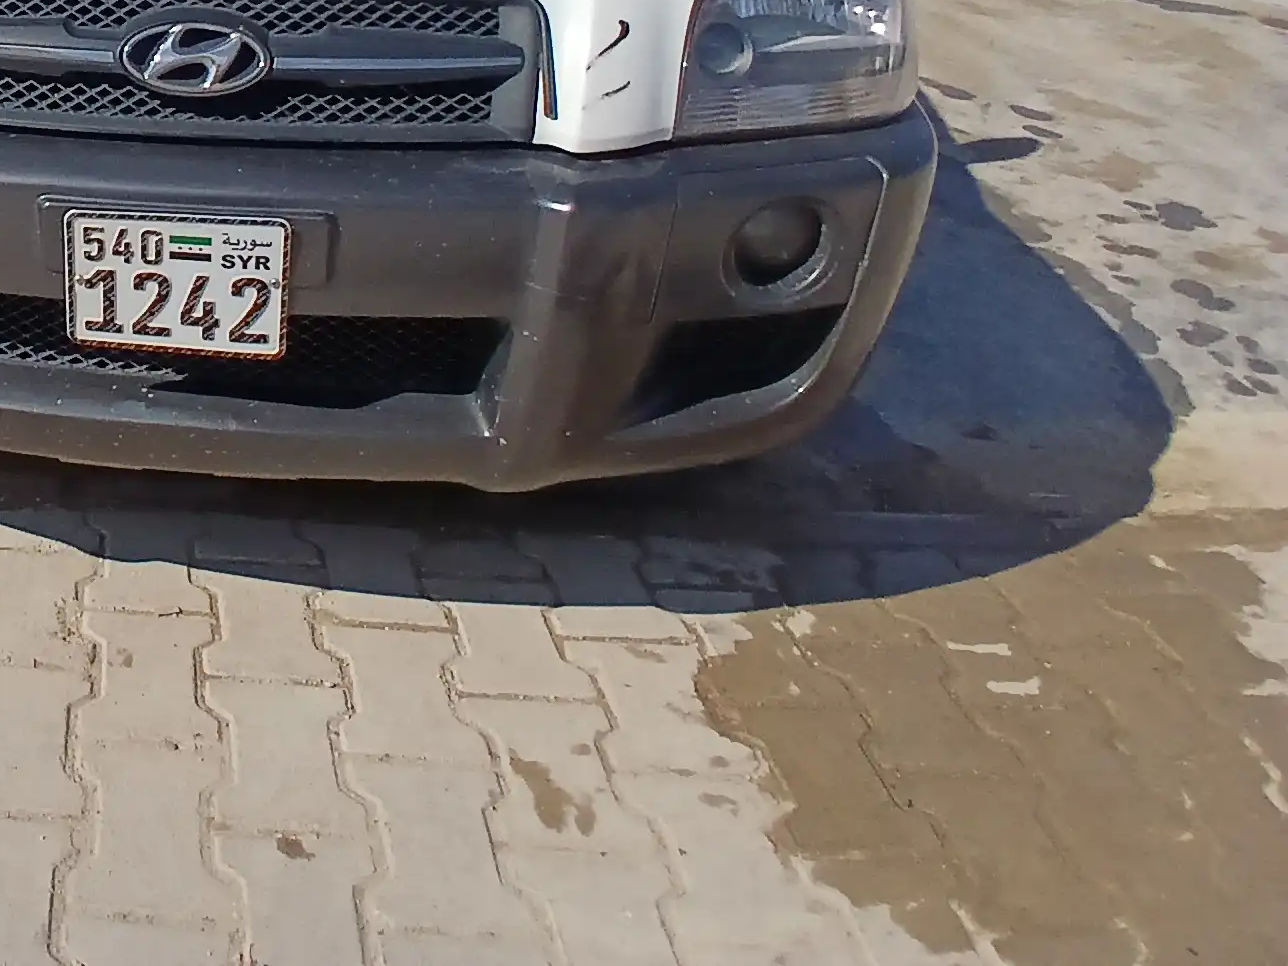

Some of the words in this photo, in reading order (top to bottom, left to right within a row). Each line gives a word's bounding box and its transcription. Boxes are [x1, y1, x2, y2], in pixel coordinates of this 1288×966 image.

[82, 226, 163, 265] 540
[222, 232, 273, 251] سورية
[220, 254, 271, 271] SYR
[83, 269, 272, 345] 1242
